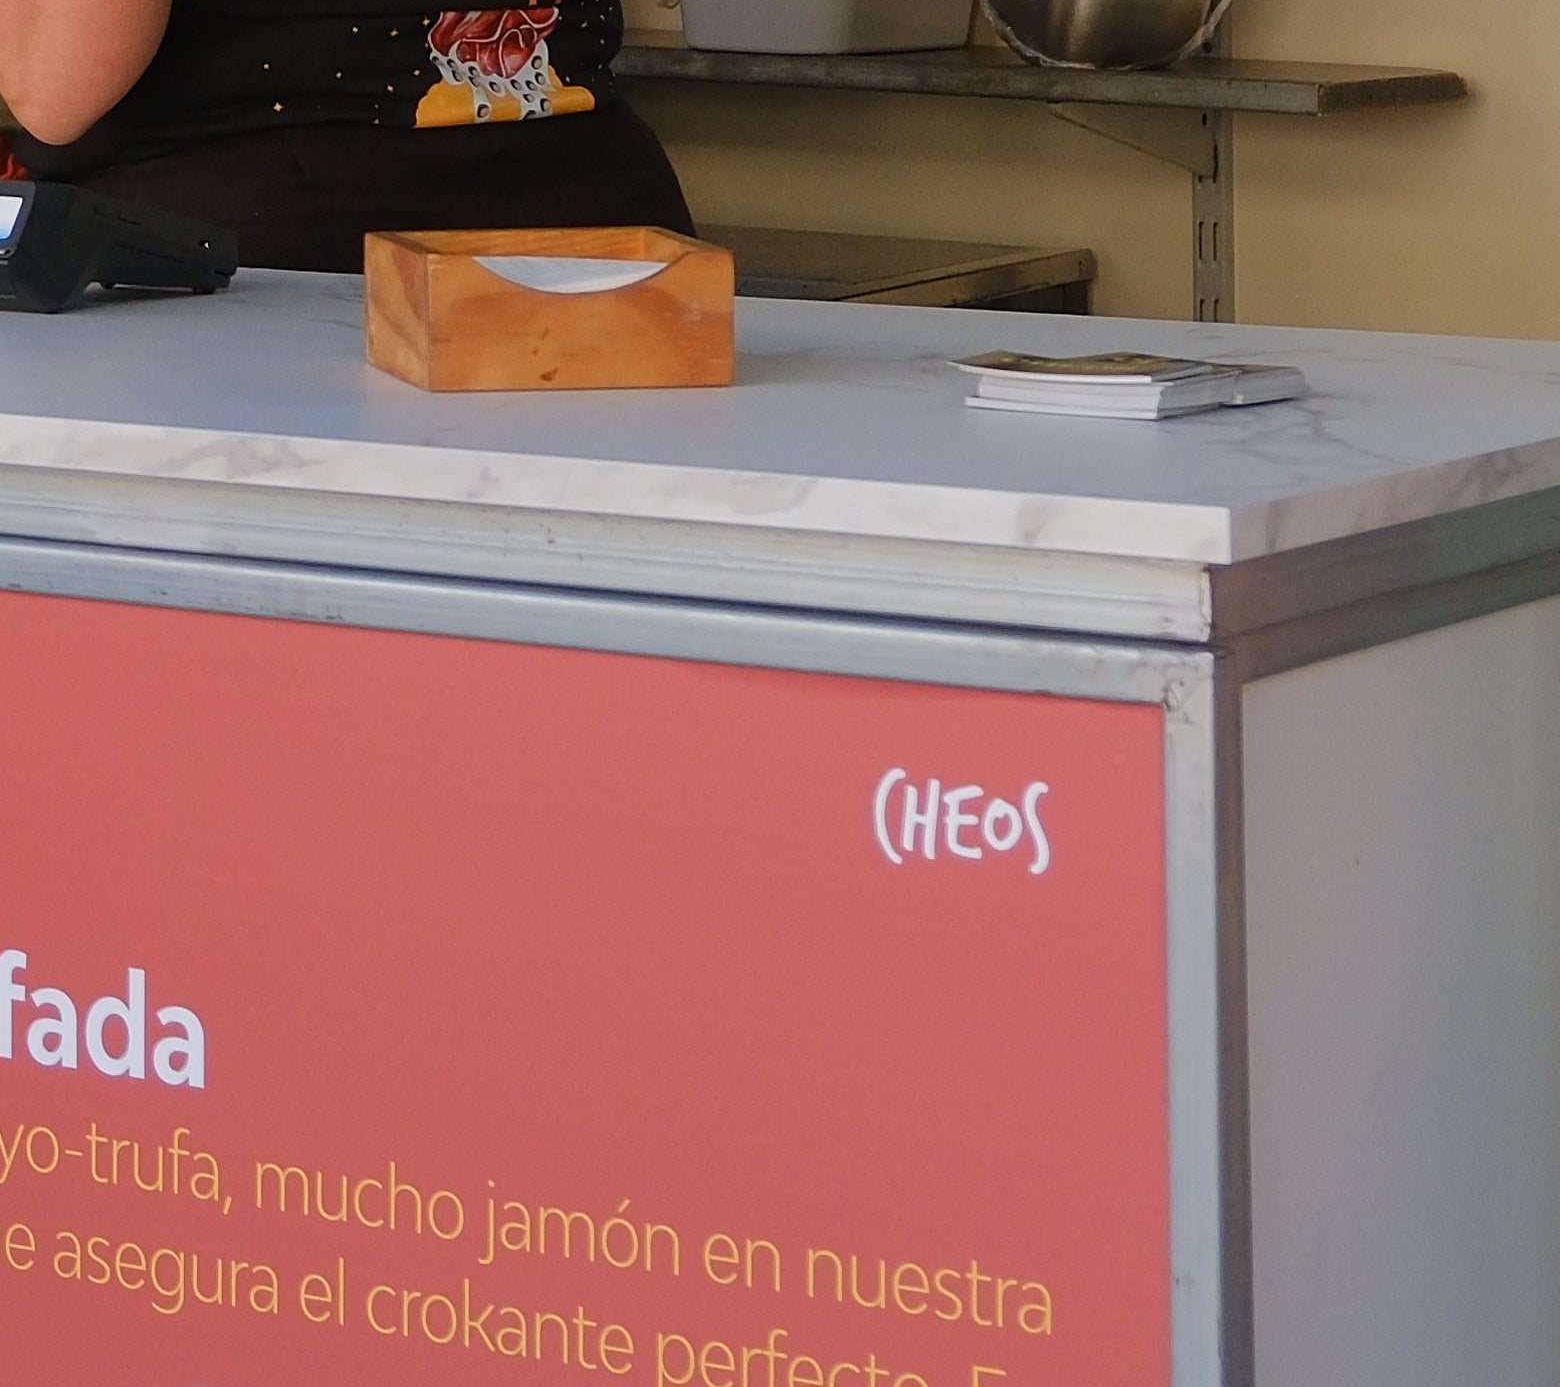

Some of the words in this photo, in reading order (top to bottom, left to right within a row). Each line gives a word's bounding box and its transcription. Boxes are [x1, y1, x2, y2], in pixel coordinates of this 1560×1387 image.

[875, 767, 1051, 875] CHEOS
[52, 1229, 279, 1316] asegura
[299, 1256, 345, 1327] el
[366, 1278, 635, 1376] crokante
[656, 1328, 931, 1387] perfet
[255, 1161, 465, 1241] mucho
[478, 1179, 692, 1277] jamón
[703, 1232, 781, 1293] en
[807, 1246, 1052, 1336] nuestra
